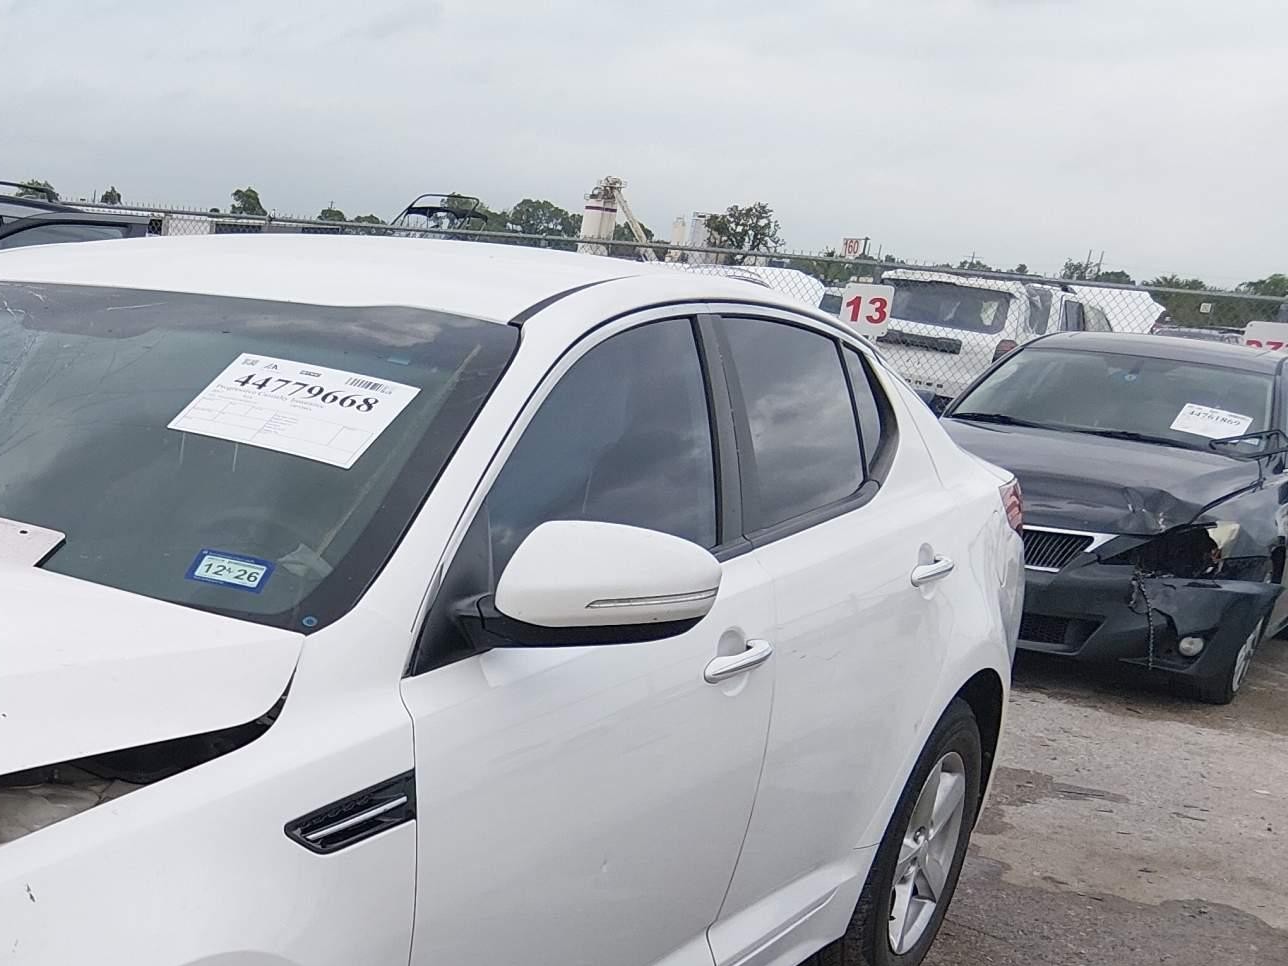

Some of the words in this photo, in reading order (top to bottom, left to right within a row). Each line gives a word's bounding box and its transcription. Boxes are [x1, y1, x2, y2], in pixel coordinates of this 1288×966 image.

[846, 296, 888, 325] 13
[234, 373, 380, 413] 44779668
[204, 562, 227, 577] 12
[233, 568, 260, 583] 26
